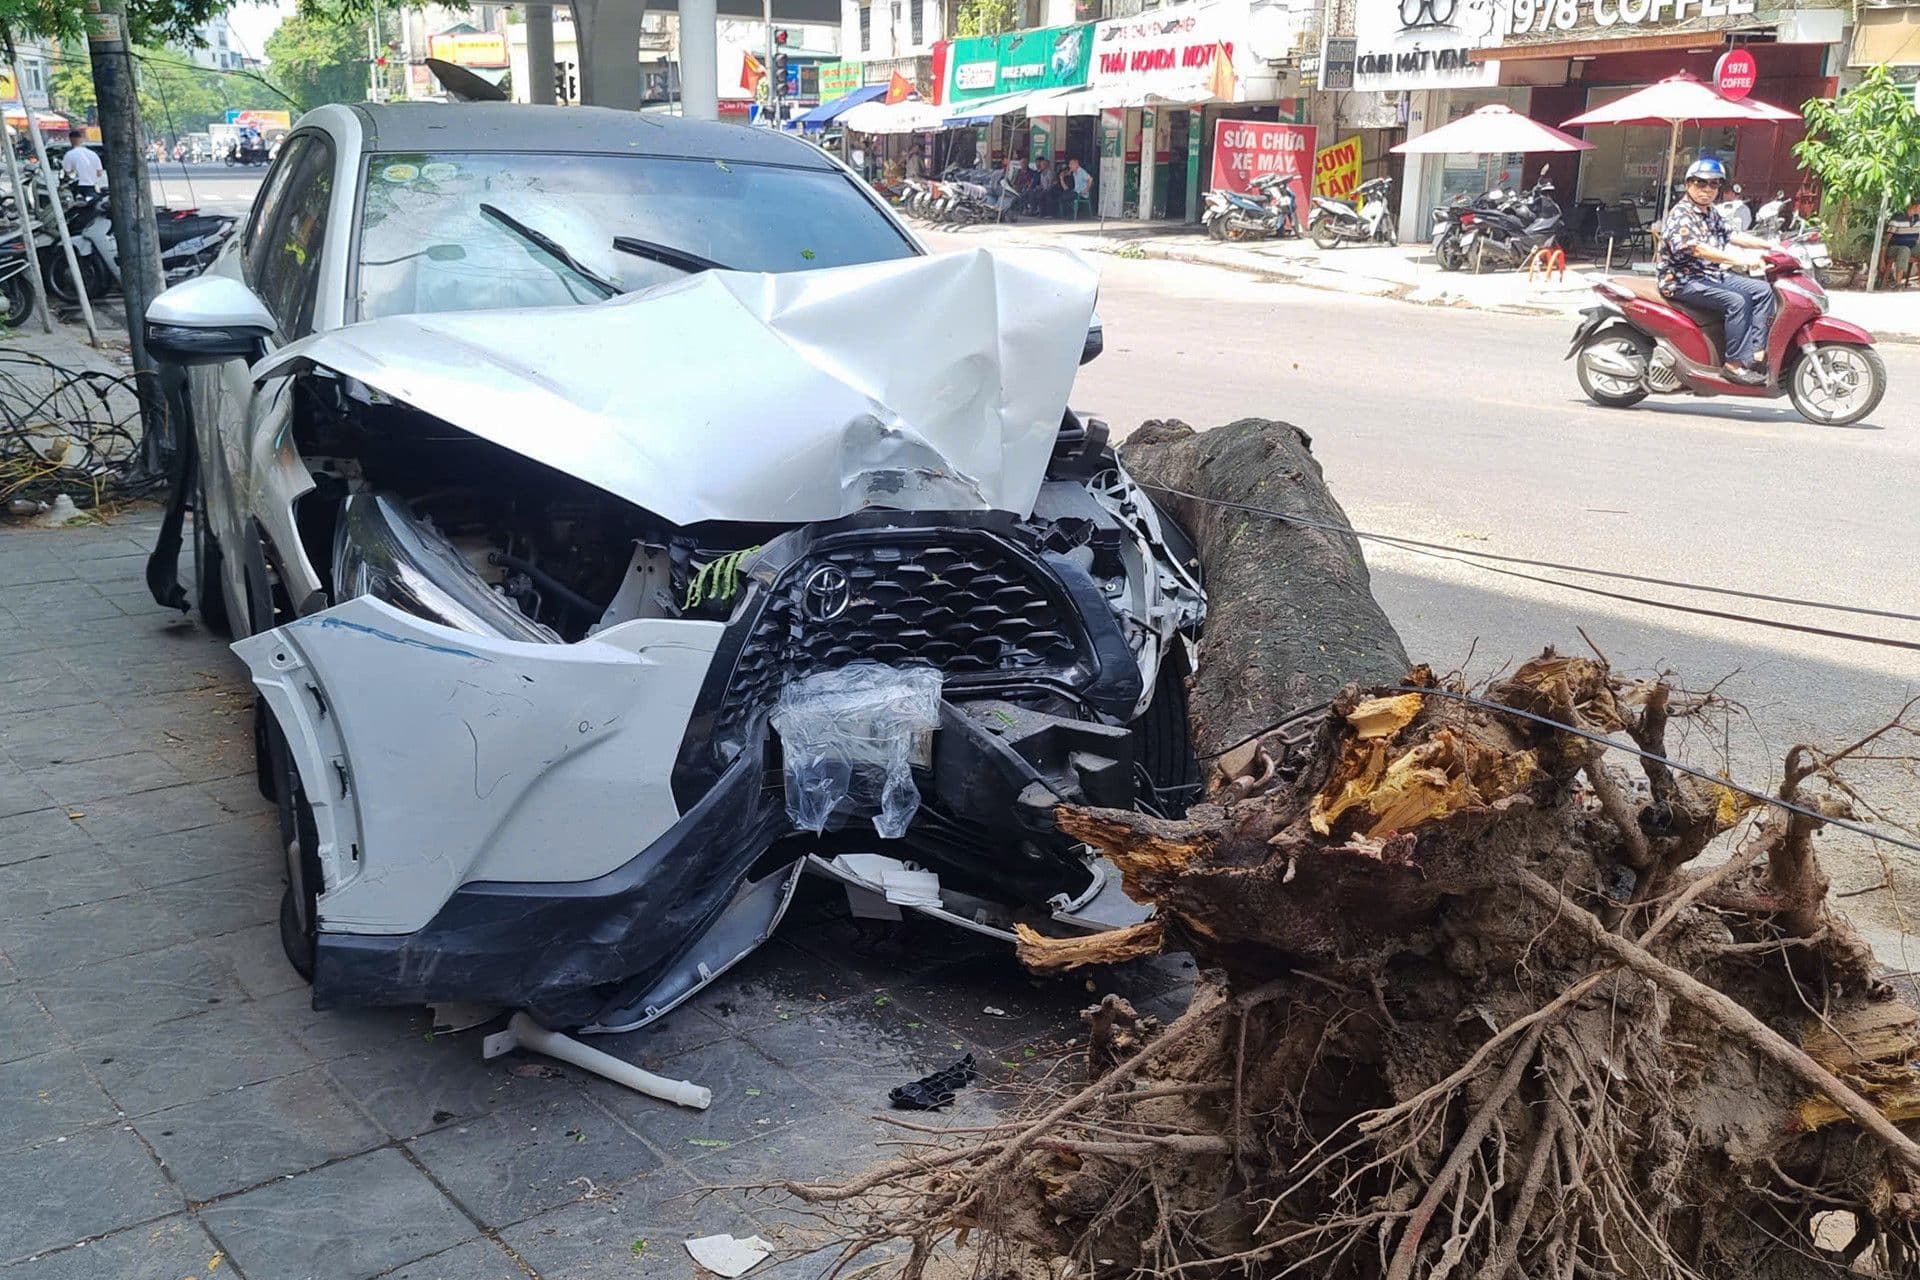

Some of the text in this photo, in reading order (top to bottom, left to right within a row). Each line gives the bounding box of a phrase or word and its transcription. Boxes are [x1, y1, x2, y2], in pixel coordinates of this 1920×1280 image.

[1503, 0, 1578, 34] 1978
[1131, 47, 1176, 72] HONDA
[1182, 41, 1234, 68] MOTR
[1356, 51, 1393, 74] KÍNH
[1432, 47, 1486, 71] VENU
[1727, 63, 1748, 73] 1978
[1721, 78, 1751, 89] COFFEE
[1223, 126, 1257, 149] SỬA
[1261, 131, 1305, 151] CHỮA
[1231, 151, 1296, 173] XE MÁY
